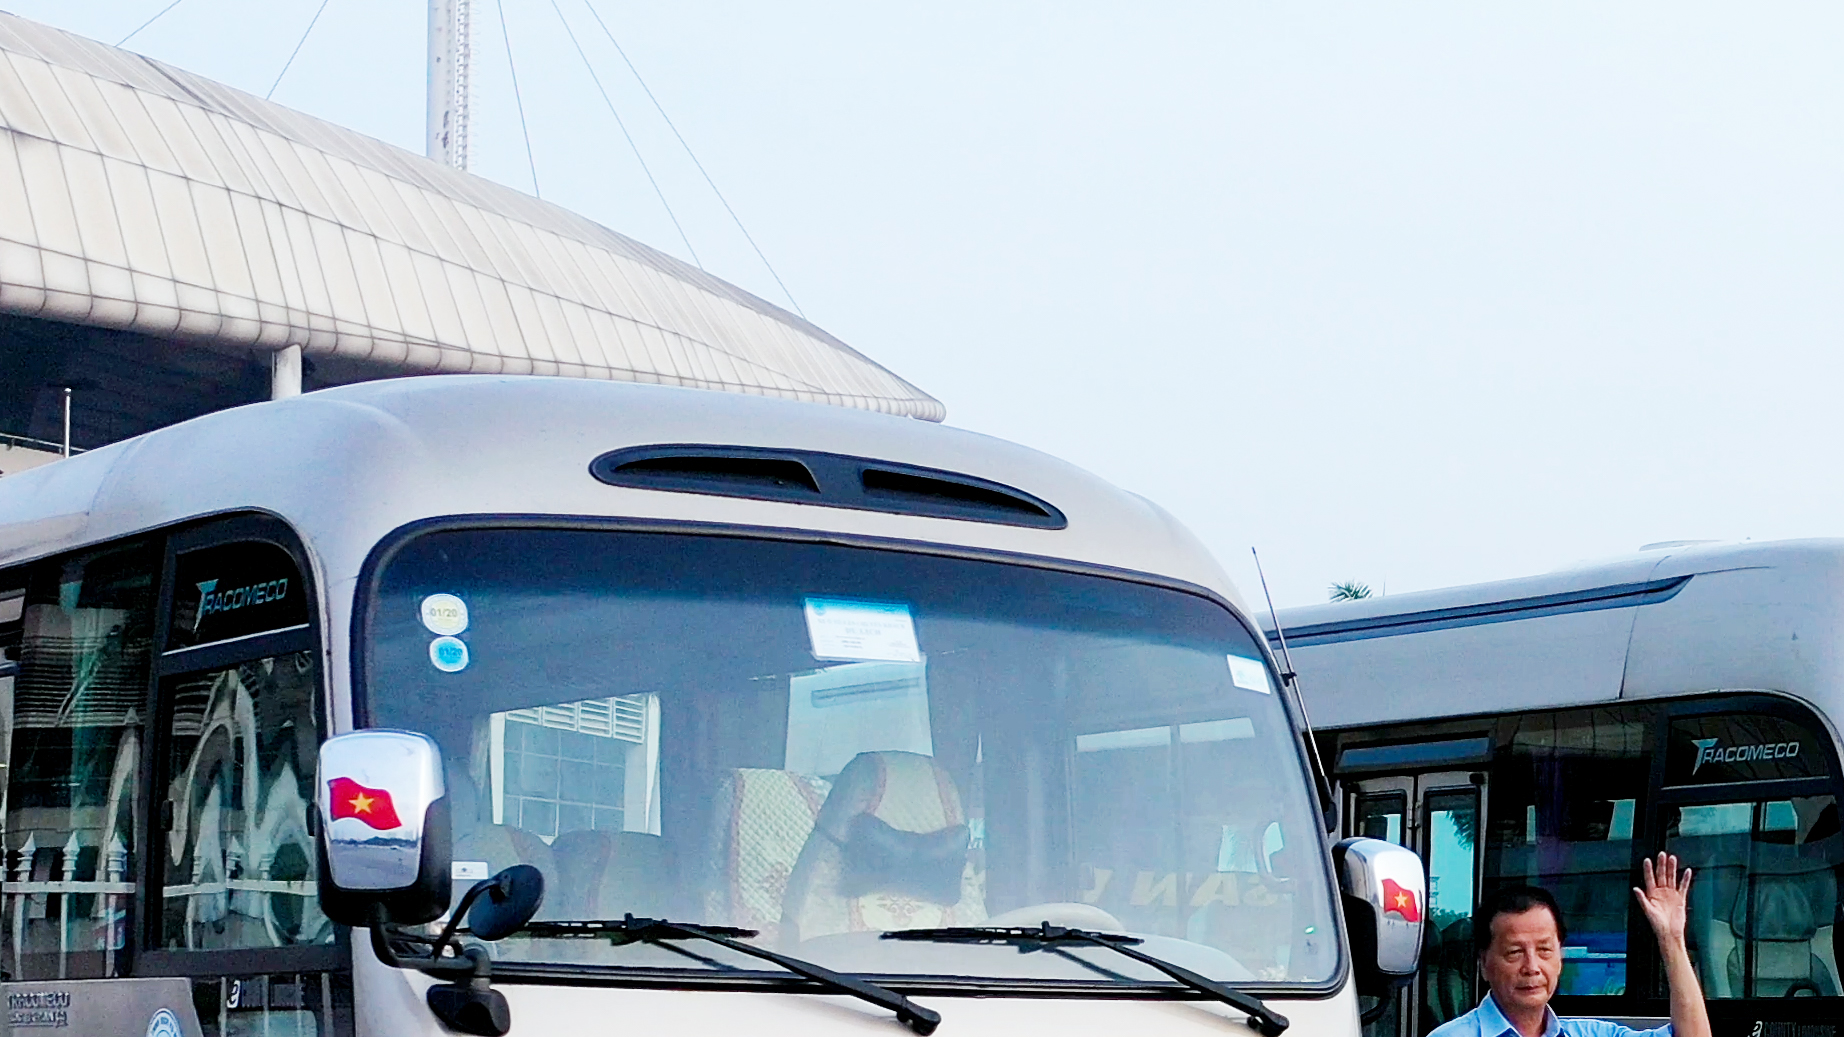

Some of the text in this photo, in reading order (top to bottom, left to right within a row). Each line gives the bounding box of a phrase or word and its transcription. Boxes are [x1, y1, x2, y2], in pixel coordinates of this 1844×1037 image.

[193, 578, 288, 634] TRACOMECO
[430, 608, 458, 618] 01/20
[1691, 738, 1800, 776] TRACOMECO
